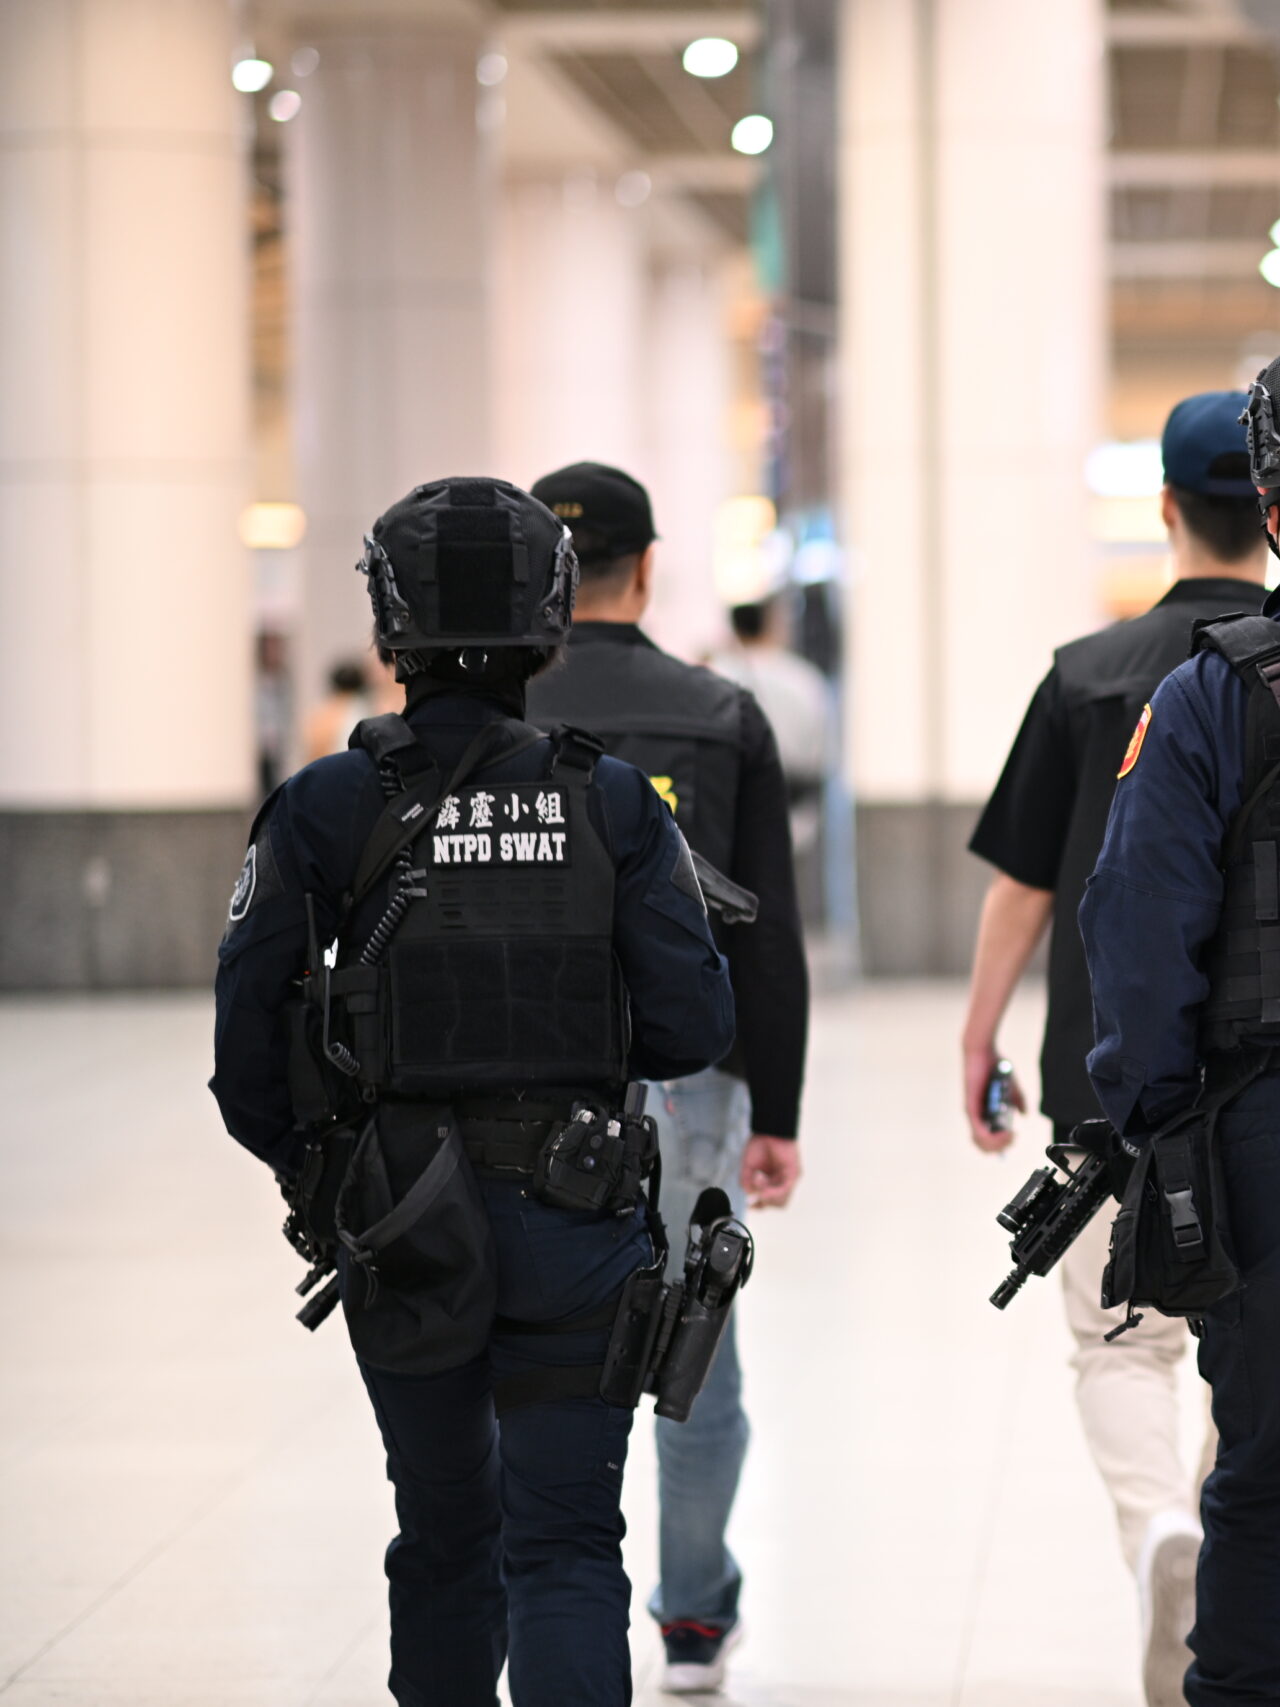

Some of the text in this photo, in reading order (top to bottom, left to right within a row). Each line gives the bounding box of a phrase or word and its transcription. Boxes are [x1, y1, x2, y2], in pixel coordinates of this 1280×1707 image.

[435, 791, 566, 830] 霹靂小組
[433, 832, 567, 864] NTPD SWAT
